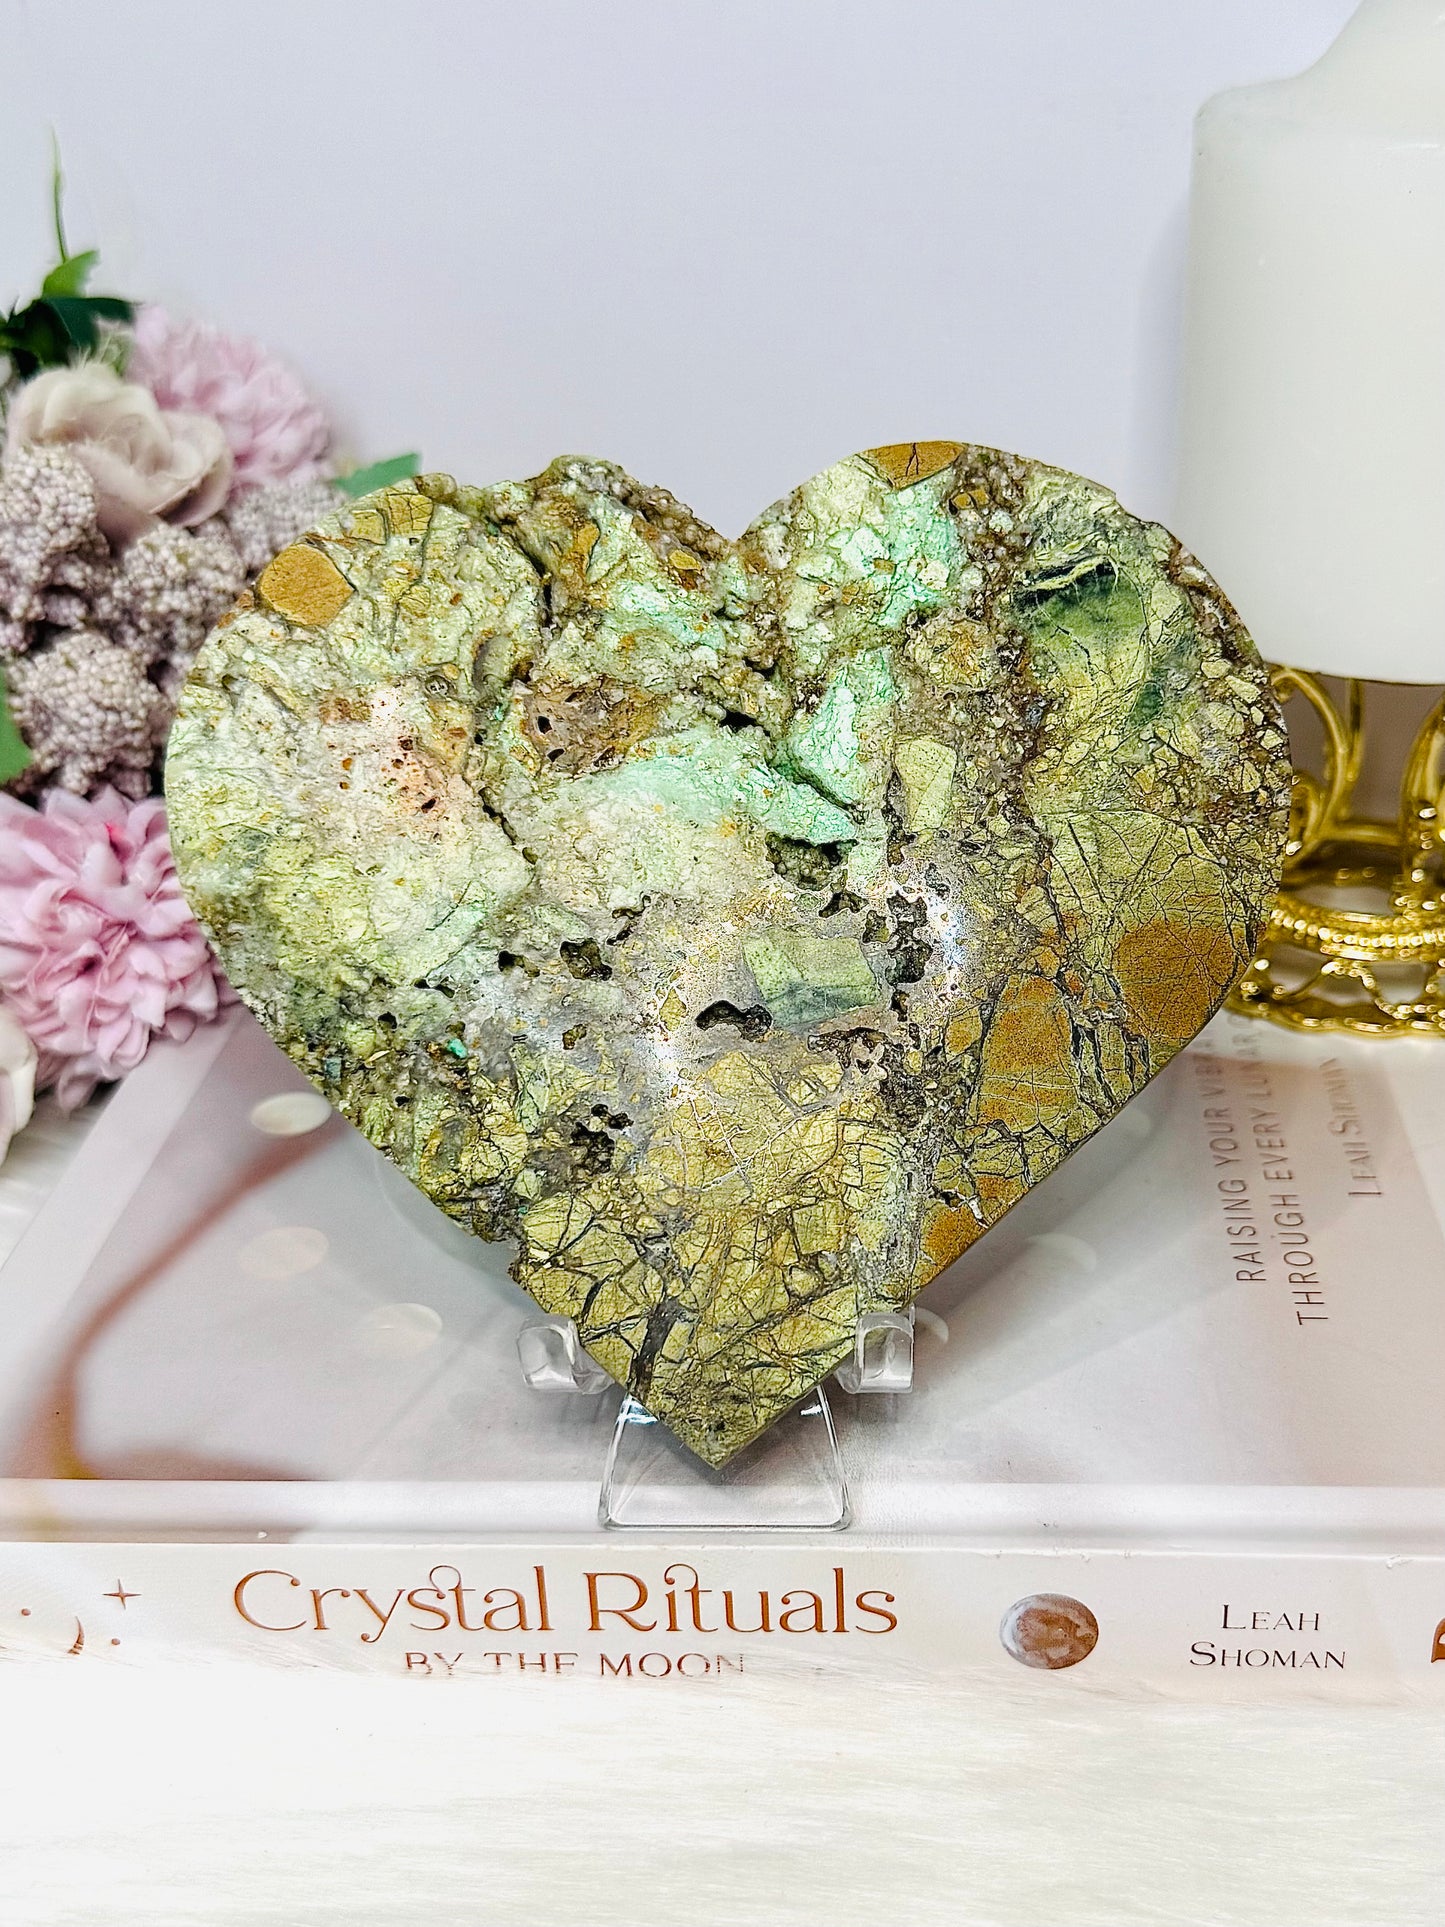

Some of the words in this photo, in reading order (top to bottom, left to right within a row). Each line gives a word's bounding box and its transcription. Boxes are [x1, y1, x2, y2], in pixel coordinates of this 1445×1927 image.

[1203, 1106, 1241, 1167] YOUR
[1250, 1107, 1294, 1181] EVERY
[1217, 1178, 1267, 1282] RAISING
[1269, 1194, 1329, 1326] THROUGH
[233, 1565, 556, 1644] Crystal
[582, 1564, 898, 1634] Rituals
[1221, 1603, 1320, 1632] LEAH
[404, 1652, 464, 1677] BY
[483, 1652, 580, 1675] THE
[600, 1652, 745, 1678] MOON
[1189, 1641, 1346, 1670] SHOMAN
